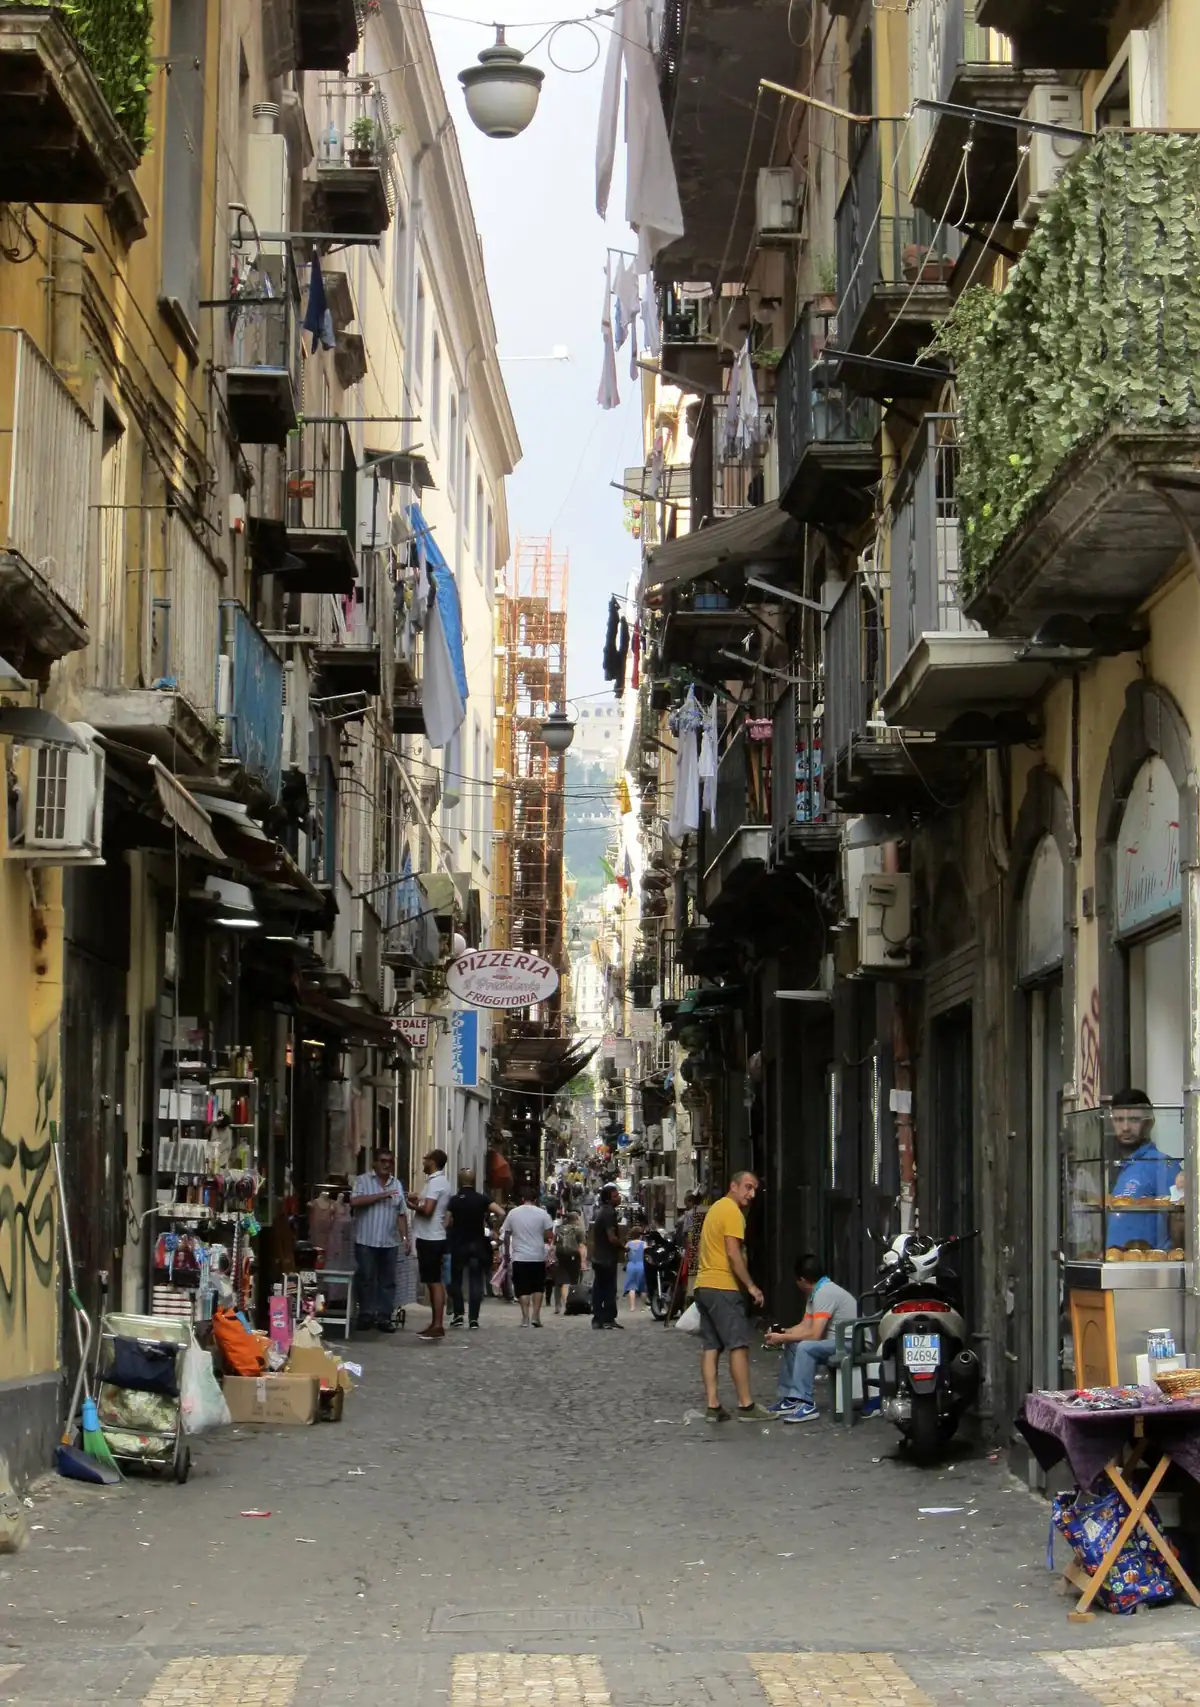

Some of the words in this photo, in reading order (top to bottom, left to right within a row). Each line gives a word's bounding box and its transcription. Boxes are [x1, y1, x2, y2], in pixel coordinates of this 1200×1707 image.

[456, 953, 551, 979] PIZZERIA
[465, 990, 538, 1006] FRIGGITORIA
[912, 1336, 926, 1347] DZ
[906, 1350, 938, 1362] 84694
